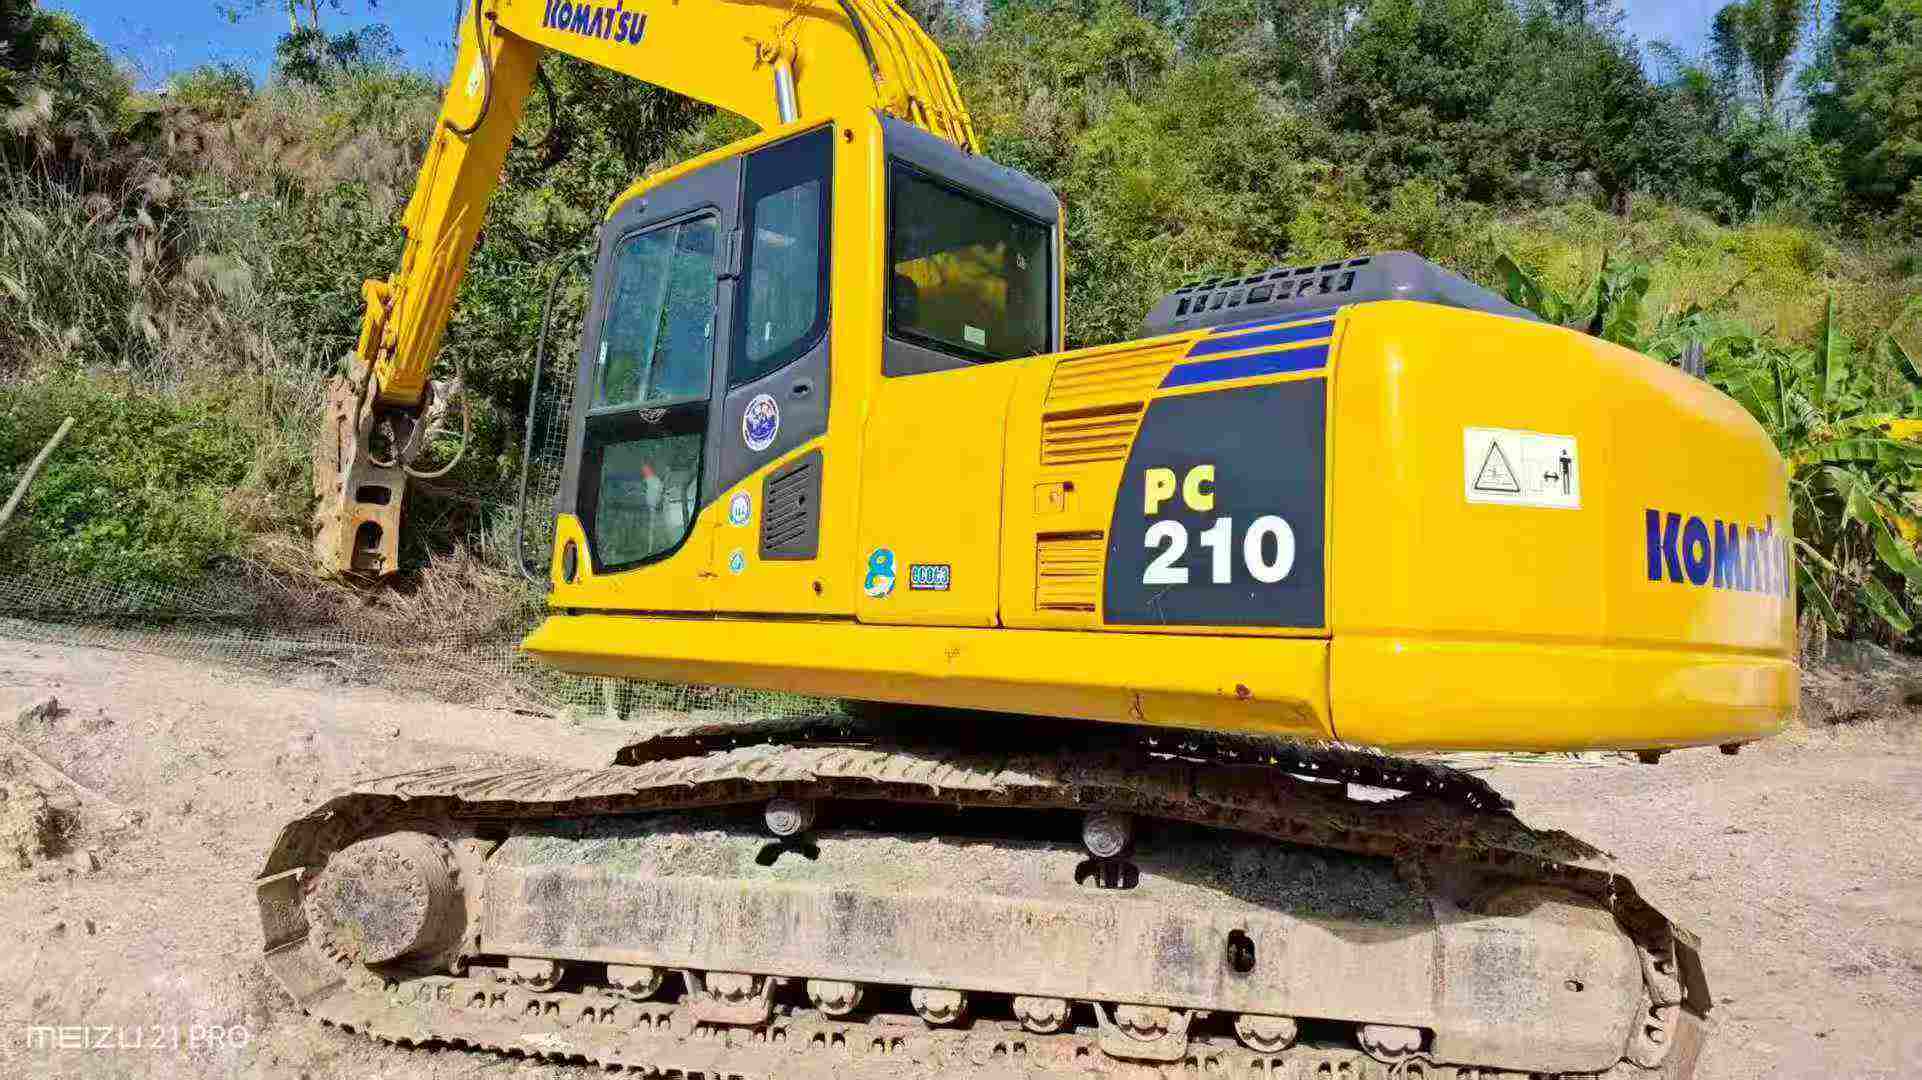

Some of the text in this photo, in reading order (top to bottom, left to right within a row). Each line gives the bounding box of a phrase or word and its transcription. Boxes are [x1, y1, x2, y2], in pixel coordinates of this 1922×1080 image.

[542, 0, 648, 45] KOMATSU
[1144, 464, 1215, 514] PC
[1143, 514, 1295, 584] 210
[1645, 508, 1790, 596] KOMAT
